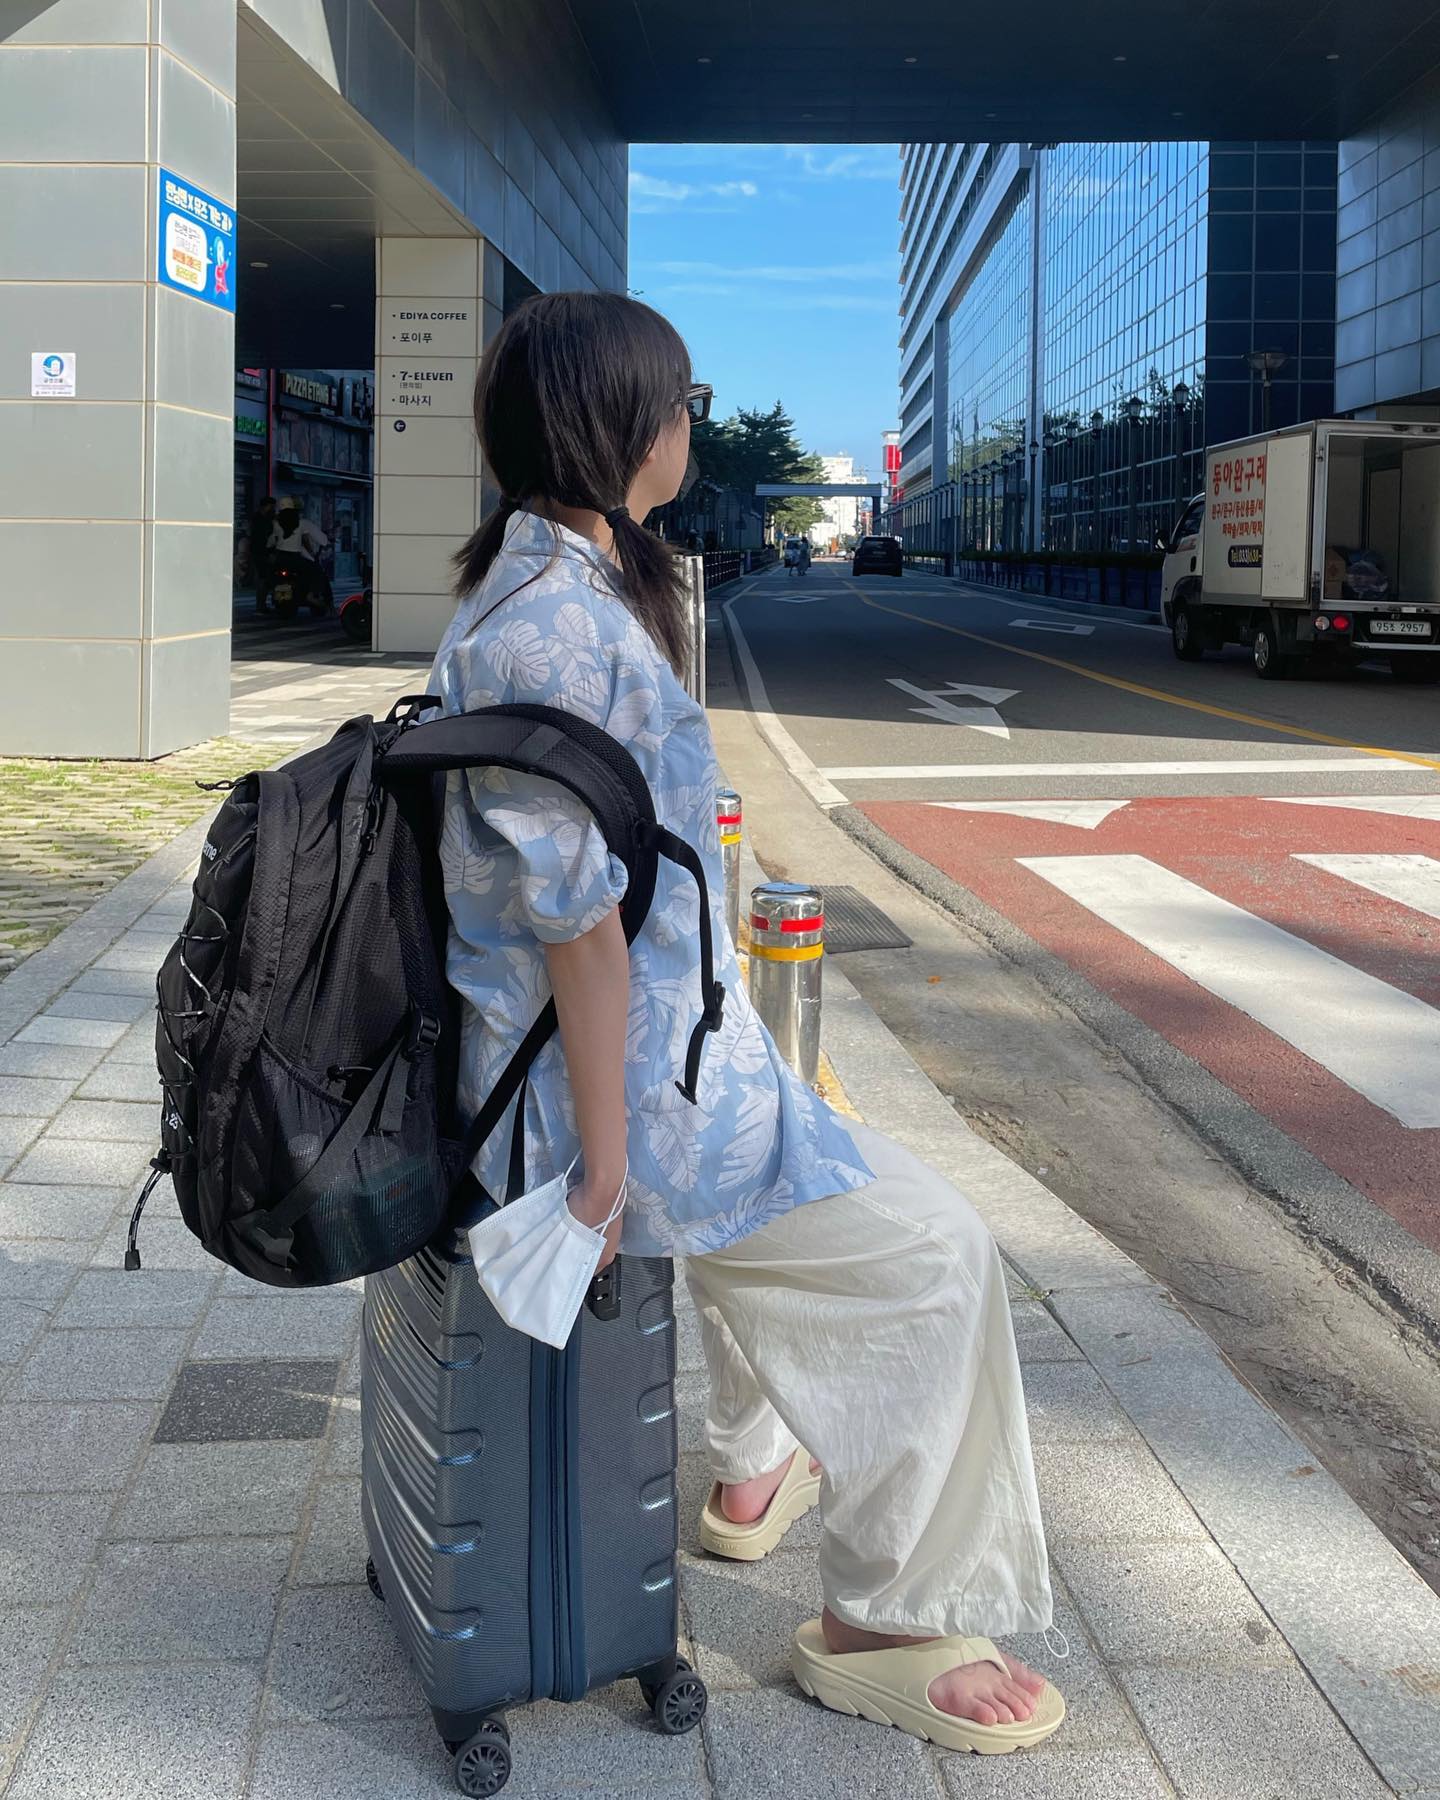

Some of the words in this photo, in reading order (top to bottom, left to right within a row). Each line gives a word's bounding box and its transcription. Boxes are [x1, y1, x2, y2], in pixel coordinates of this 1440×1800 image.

[400, 312, 429, 320] EDIYA
[430, 312, 468, 320] COFFEE
[400, 332, 433, 344] 포이푸
[399, 395, 432, 406] 마사지
[1400, 622, 1425, 633] 2957
